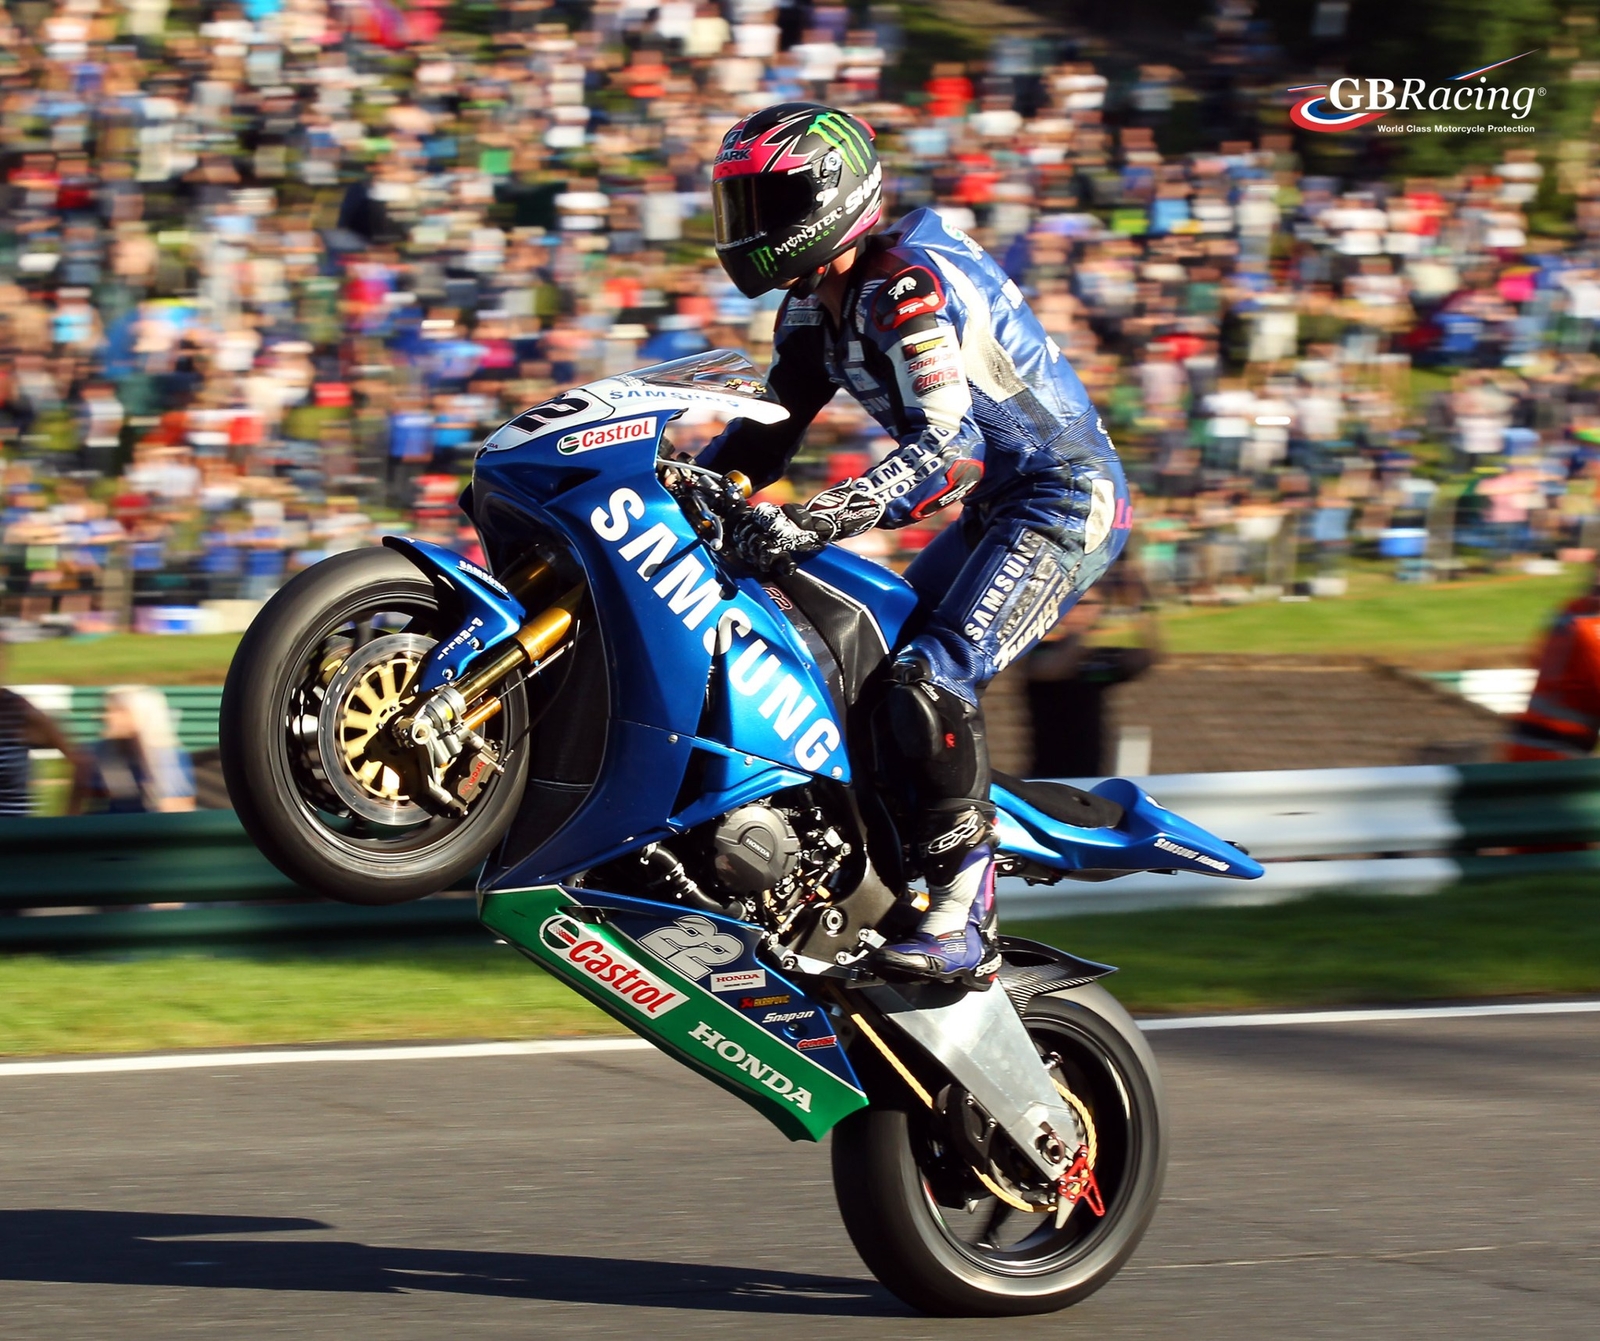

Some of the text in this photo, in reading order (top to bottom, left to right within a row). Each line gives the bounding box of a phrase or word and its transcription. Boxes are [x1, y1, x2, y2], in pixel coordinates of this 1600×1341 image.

[774, 206, 843, 255] MONSTER
[790, 225, 837, 258] ENERGY
[582, 420, 650, 447] Castrol
[855, 427, 950, 492] SAMSUNG
[964, 531, 1043, 641] SAMSUNG
[437, 617, 484, 660] PIRELLI
[590, 487, 841, 771] SAMSUNG
[745, 838, 770, 858] HONDA
[637, 915, 744, 983] 22
[568, 940, 676, 1013] Castrol
[716, 974, 761, 983] HONDA
[762, 1010, 815, 1024] Snap-on
[688, 1021, 812, 1113] HONDA
